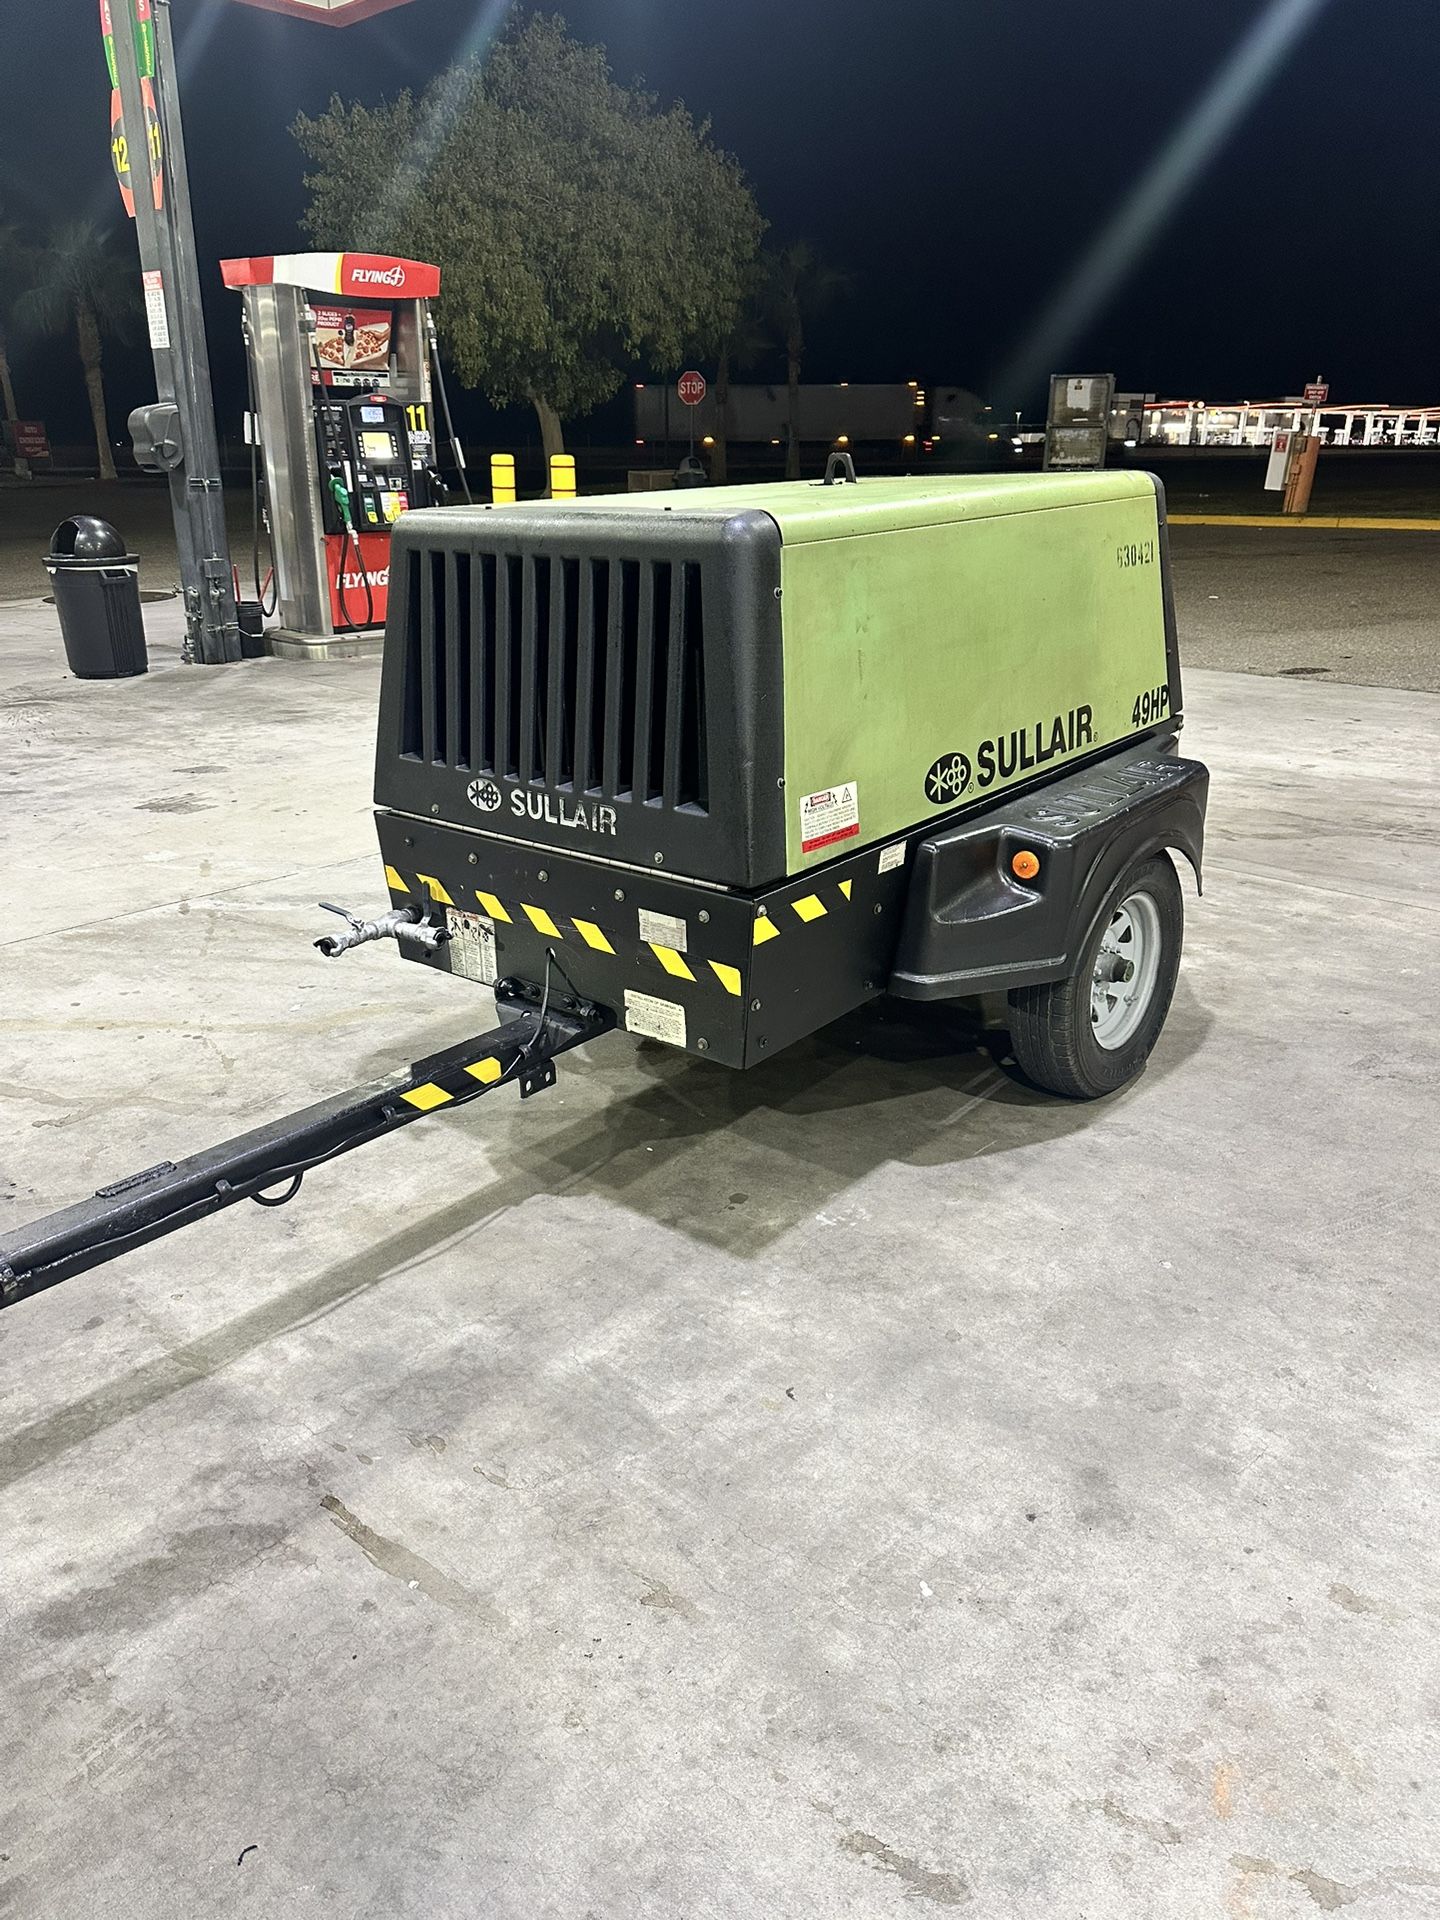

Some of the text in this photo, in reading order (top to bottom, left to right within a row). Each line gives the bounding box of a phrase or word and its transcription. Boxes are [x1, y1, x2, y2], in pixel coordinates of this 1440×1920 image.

[112, 136, 130, 173] 12
[147, 121, 161, 160] 11
[352, 268, 391, 285] FLYING
[680, 381, 704, 394] STOP
[406, 405, 426, 431] 11
[1116, 540, 1153, 568] 630421
[1131, 684, 1169, 728] 49HP
[977, 704, 1093, 788] SULLAIR
[510, 788, 617, 836] SULLAIR
[1026, 760, 1186, 827] SULLAIR
